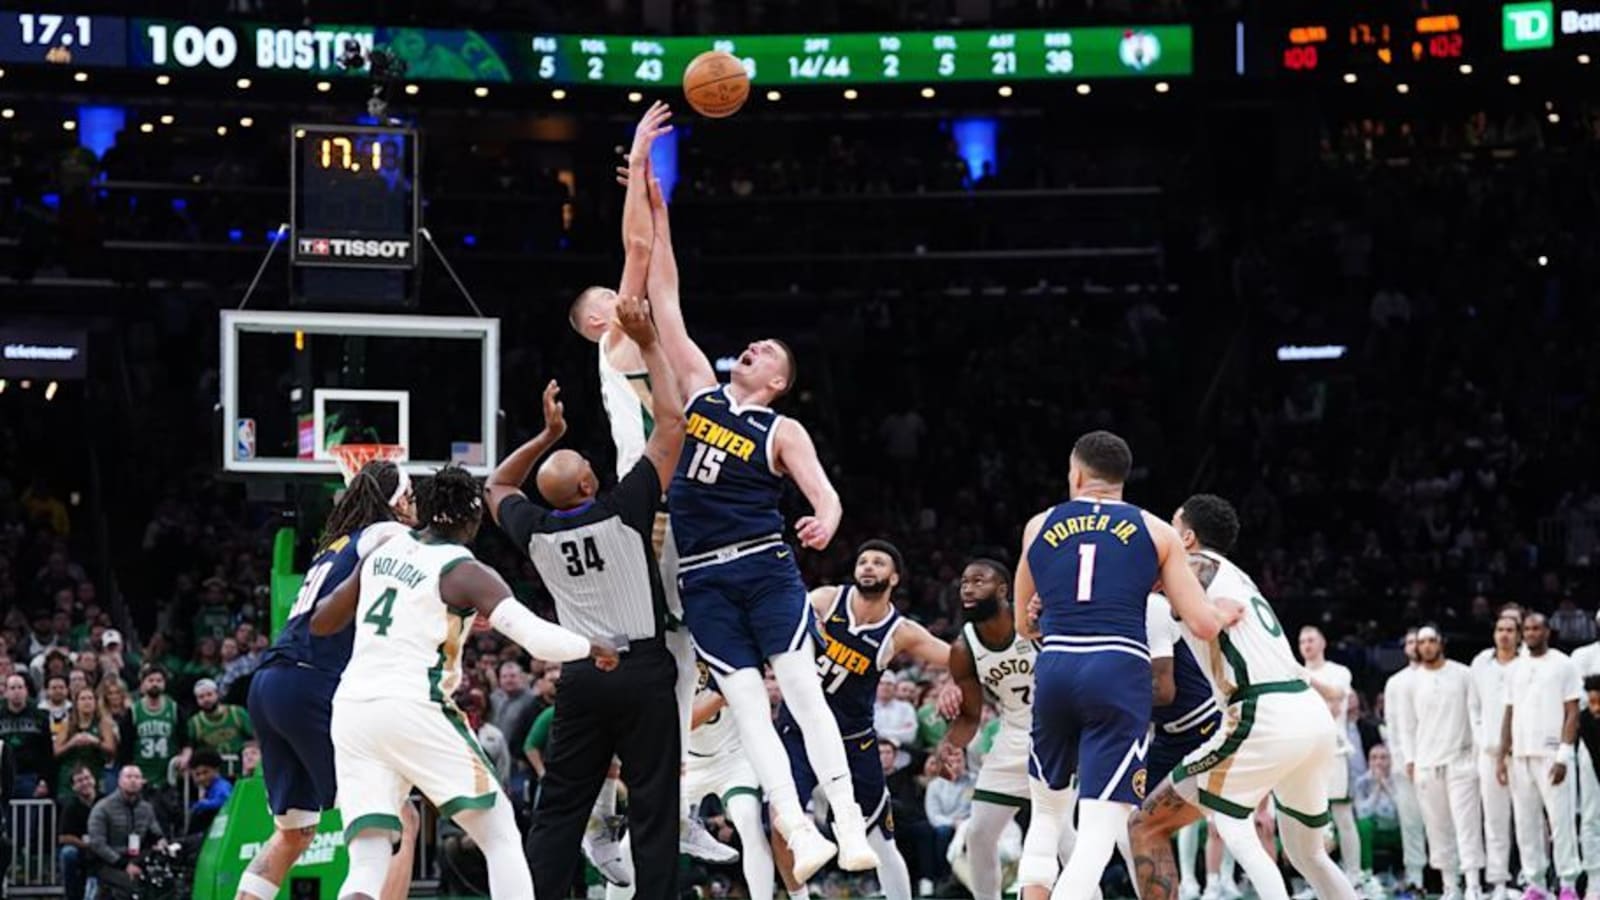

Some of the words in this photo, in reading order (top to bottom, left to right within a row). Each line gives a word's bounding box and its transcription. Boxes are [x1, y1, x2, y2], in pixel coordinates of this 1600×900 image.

[19, 14, 91, 46] 17.1
[148, 26, 237, 67] 100
[538, 55, 556, 79] 5
[586, 56, 604, 79] 2
[635, 58, 663, 82] 43
[788, 55, 850, 78] 14/44
[883, 54, 900, 78] 2
[938, 52, 955, 76] 5
[991, 51, 1016, 75] 21
[320, 137, 382, 172] 17.1
[329, 239, 410, 258] TISSOT
[685, 411, 757, 463] DENVER
[686, 441, 728, 485] 15
[1042, 514, 1111, 548] PORTER
[372, 556, 428, 590] HOLIDAY
[560, 535, 606, 577] 34
[1077, 543, 1097, 602] 1
[363, 587, 399, 637] 4
[1250, 596, 1282, 638] 0
[824, 634, 872, 676] NVER
[984, 658, 1036, 687] BOSTO
[1011, 685, 1032, 706] 7
[140, 737, 169, 759] 34
